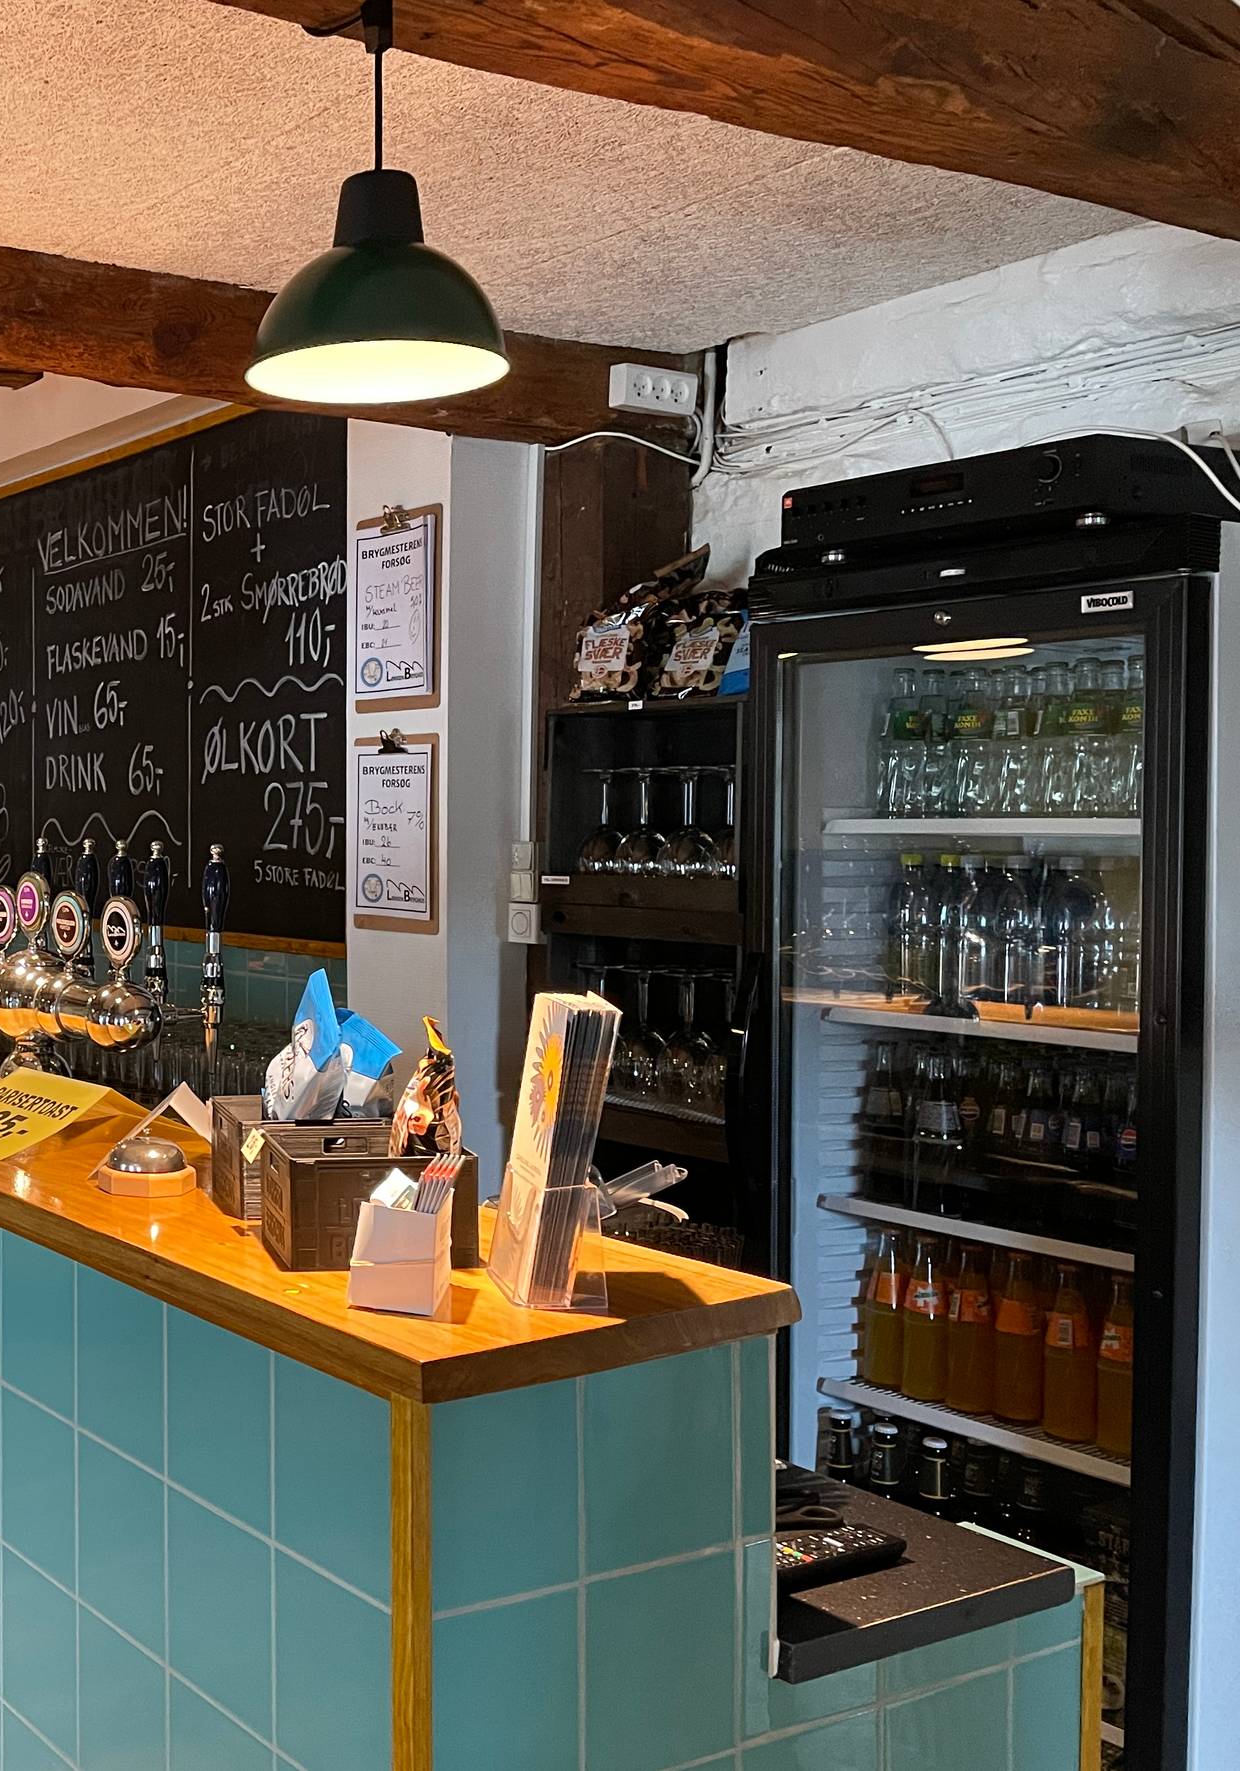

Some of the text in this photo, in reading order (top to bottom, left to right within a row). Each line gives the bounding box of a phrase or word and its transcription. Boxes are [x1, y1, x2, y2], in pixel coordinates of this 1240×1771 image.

[37, 484, 187, 573] VELKOMMEN!
[202, 483, 331, 542] STOR FADØL
[381, 555, 411, 570] FORSØG
[46, 568, 126, 615] SODAVAND
[1086, 596, 1128, 608] VIBOCOLD
[46, 629, 148, 680] FLASKEVAND
[46, 695, 78, 739] VIN
[201, 711, 328, 785] ØLKORT
[45, 752, 107, 793] DRINK
[362, 765, 425, 776] BRYGMESTERENS
[382, 779, 411, 788] FORSØG
[254, 860, 346, 891] 5 STORE FADØL
